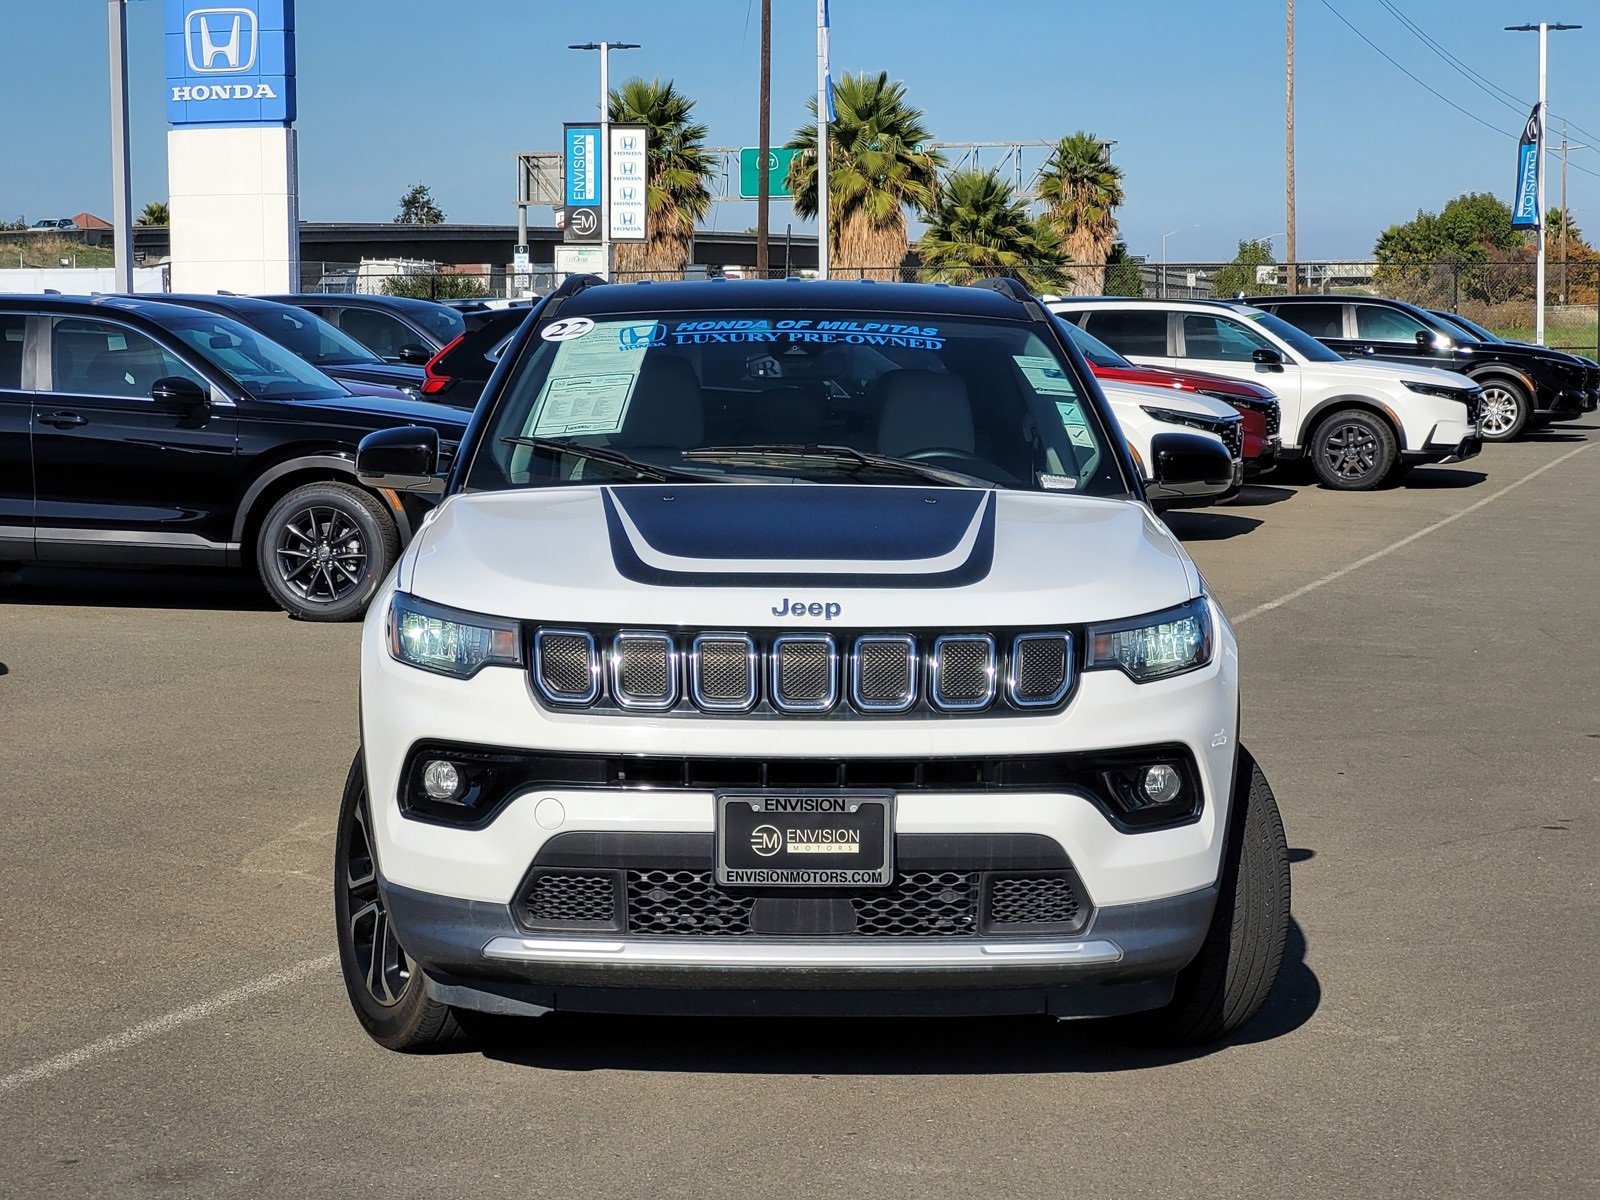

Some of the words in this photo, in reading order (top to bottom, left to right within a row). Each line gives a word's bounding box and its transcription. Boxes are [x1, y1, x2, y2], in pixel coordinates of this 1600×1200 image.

[171, 84, 277, 101] HONDA
[573, 134, 585, 200] ENVISION
[1523, 150, 1536, 217] ENVISION
[546, 321, 589, 338] 22
[676, 320, 768, 331] HONDA
[776, 320, 813, 329] OF
[816, 320, 938, 336] MILPITAS
[619, 342, 667, 352] HONDA
[675, 332, 782, 345] LUXURY
[787, 333, 943, 350] PRE-OWNED
[771, 598, 841, 620] Jeep
[764, 799, 846, 812] ENVISION
[786, 829, 860, 843] ENVISION
[726, 870, 882, 883] ENVISIONMOTORS.COM
